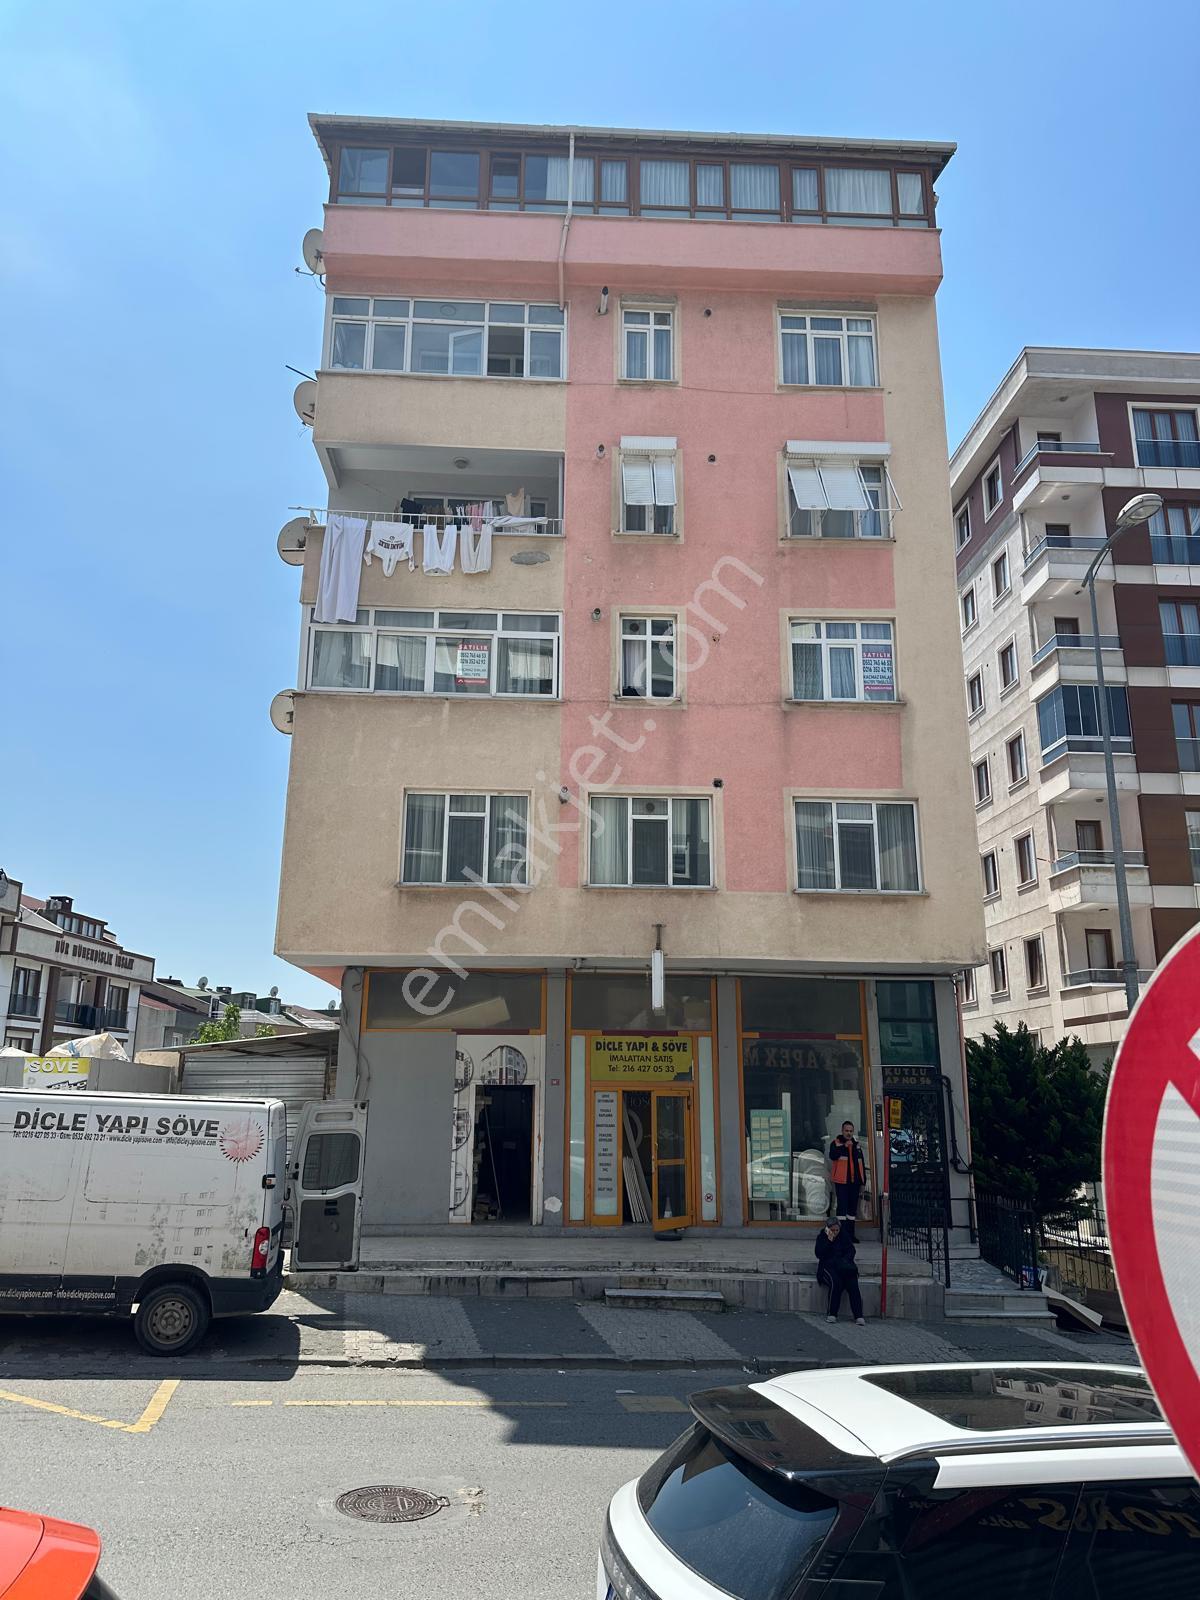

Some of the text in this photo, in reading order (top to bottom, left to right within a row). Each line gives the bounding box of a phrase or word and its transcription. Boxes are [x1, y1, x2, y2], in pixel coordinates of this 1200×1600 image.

[595, 1038, 688, 1052] DİCLE YAPI & SÖVE
[609, 1054, 674, 1064] İMALATTAN SATIŞ
[29, 1058, 80, 1074] SÖVE
[884, 1068, 927, 1076] KUTLU
[902, 1076, 917, 1084] NO
[14, 1108, 220, 1138] DİCLE YAPI SÖVE
